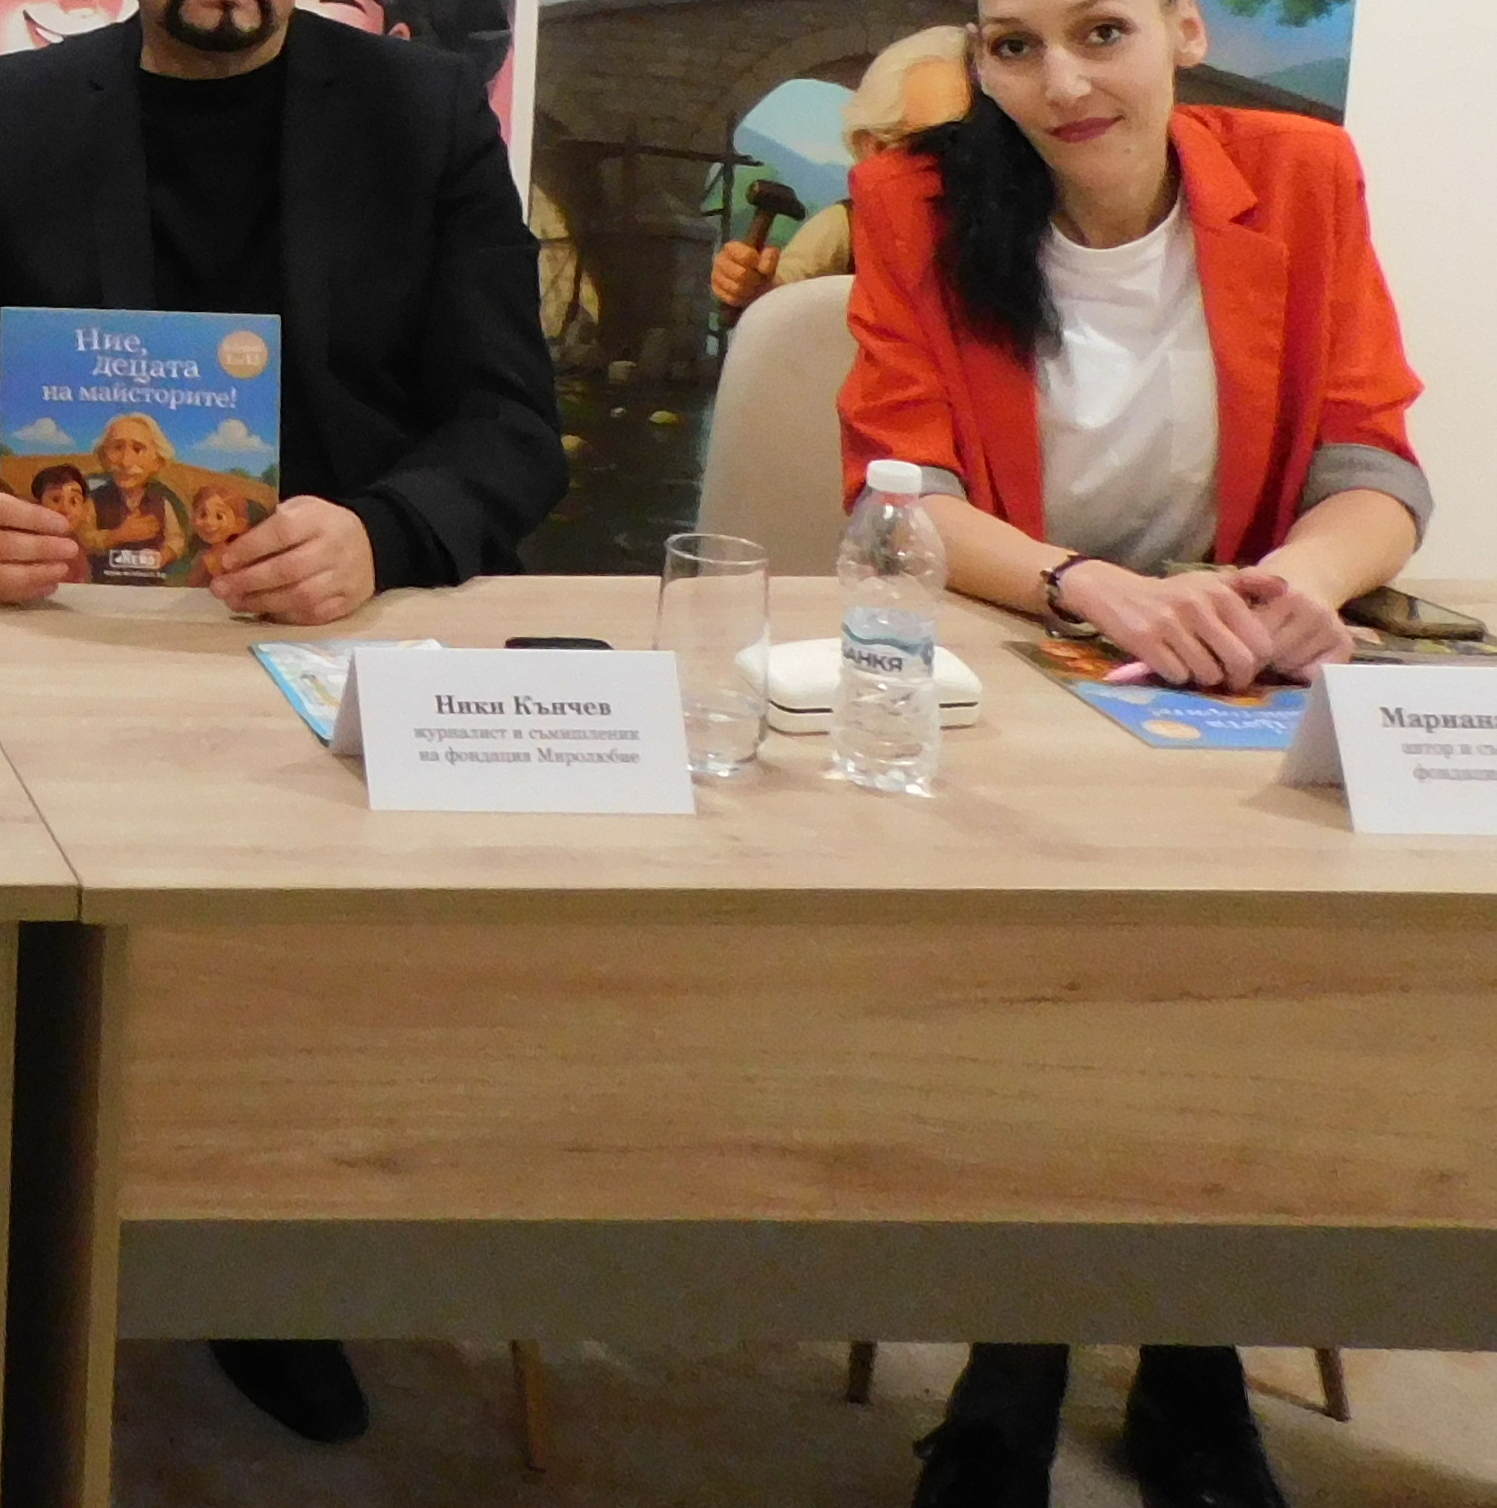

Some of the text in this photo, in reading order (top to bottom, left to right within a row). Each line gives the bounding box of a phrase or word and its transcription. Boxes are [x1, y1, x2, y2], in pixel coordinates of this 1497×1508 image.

[74, 327, 148, 355] Ние,
[92, 355, 200, 383] децата
[41, 381, 237, 410] на майсторите!
[843, 647, 902, 672] АНКЯ
[435, 695, 612, 716] Ники Кънчев
[1379, 706, 1497, 733] Мариан
